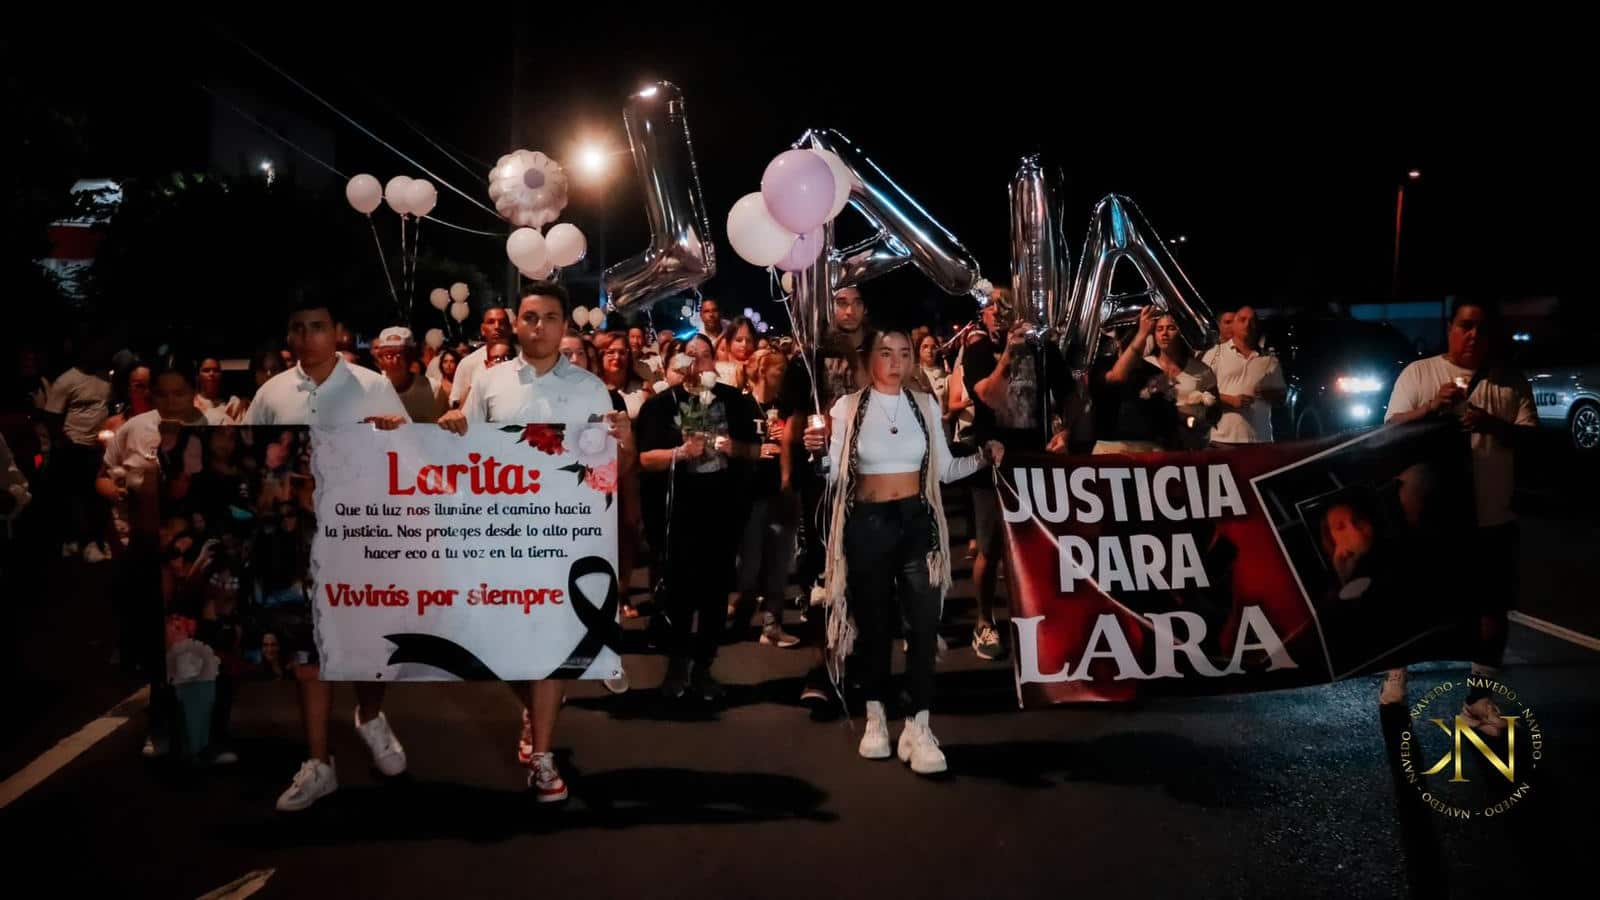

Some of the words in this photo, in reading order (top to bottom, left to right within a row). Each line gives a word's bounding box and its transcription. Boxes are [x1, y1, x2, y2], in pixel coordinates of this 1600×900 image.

[386, 451, 541, 496] Larita:
[1002, 463, 1247, 523] JUSTICIA
[335, 503, 361, 516] Que
[366, 504, 379, 516] tú
[383, 503, 401, 516] luz
[406, 506, 430, 516] nos
[435, 503, 482, 516] ilumine
[487, 504, 498, 515] el
[502, 502, 550, 515] camino
[555, 501, 591, 515] hacia
[325, 525, 337, 537] la
[343, 525, 392, 540] justicia.
[397, 524, 421, 538] Nos
[426, 526, 481, 542] proteges
[485, 523, 522, 537] desde
[527, 524, 538, 537] lo
[543, 524, 568, 537] alto
[572, 527, 602, 541] para
[365, 546, 401, 559] hacer
[405, 549, 427, 559] eco
[432, 549, 440, 559] a
[445, 547, 458, 559] tu
[463, 549, 485, 559] voz
[489, 549, 506, 558] en
[511, 546, 523, 558] la
[528, 545, 568, 558] tierra.
[1059, 533, 1210, 592] PARA
[324, 583, 409, 607] Vivirás
[417, 589, 459, 616] por
[466, 583, 565, 615] siempre
[1011, 605, 1300, 685] LARA
